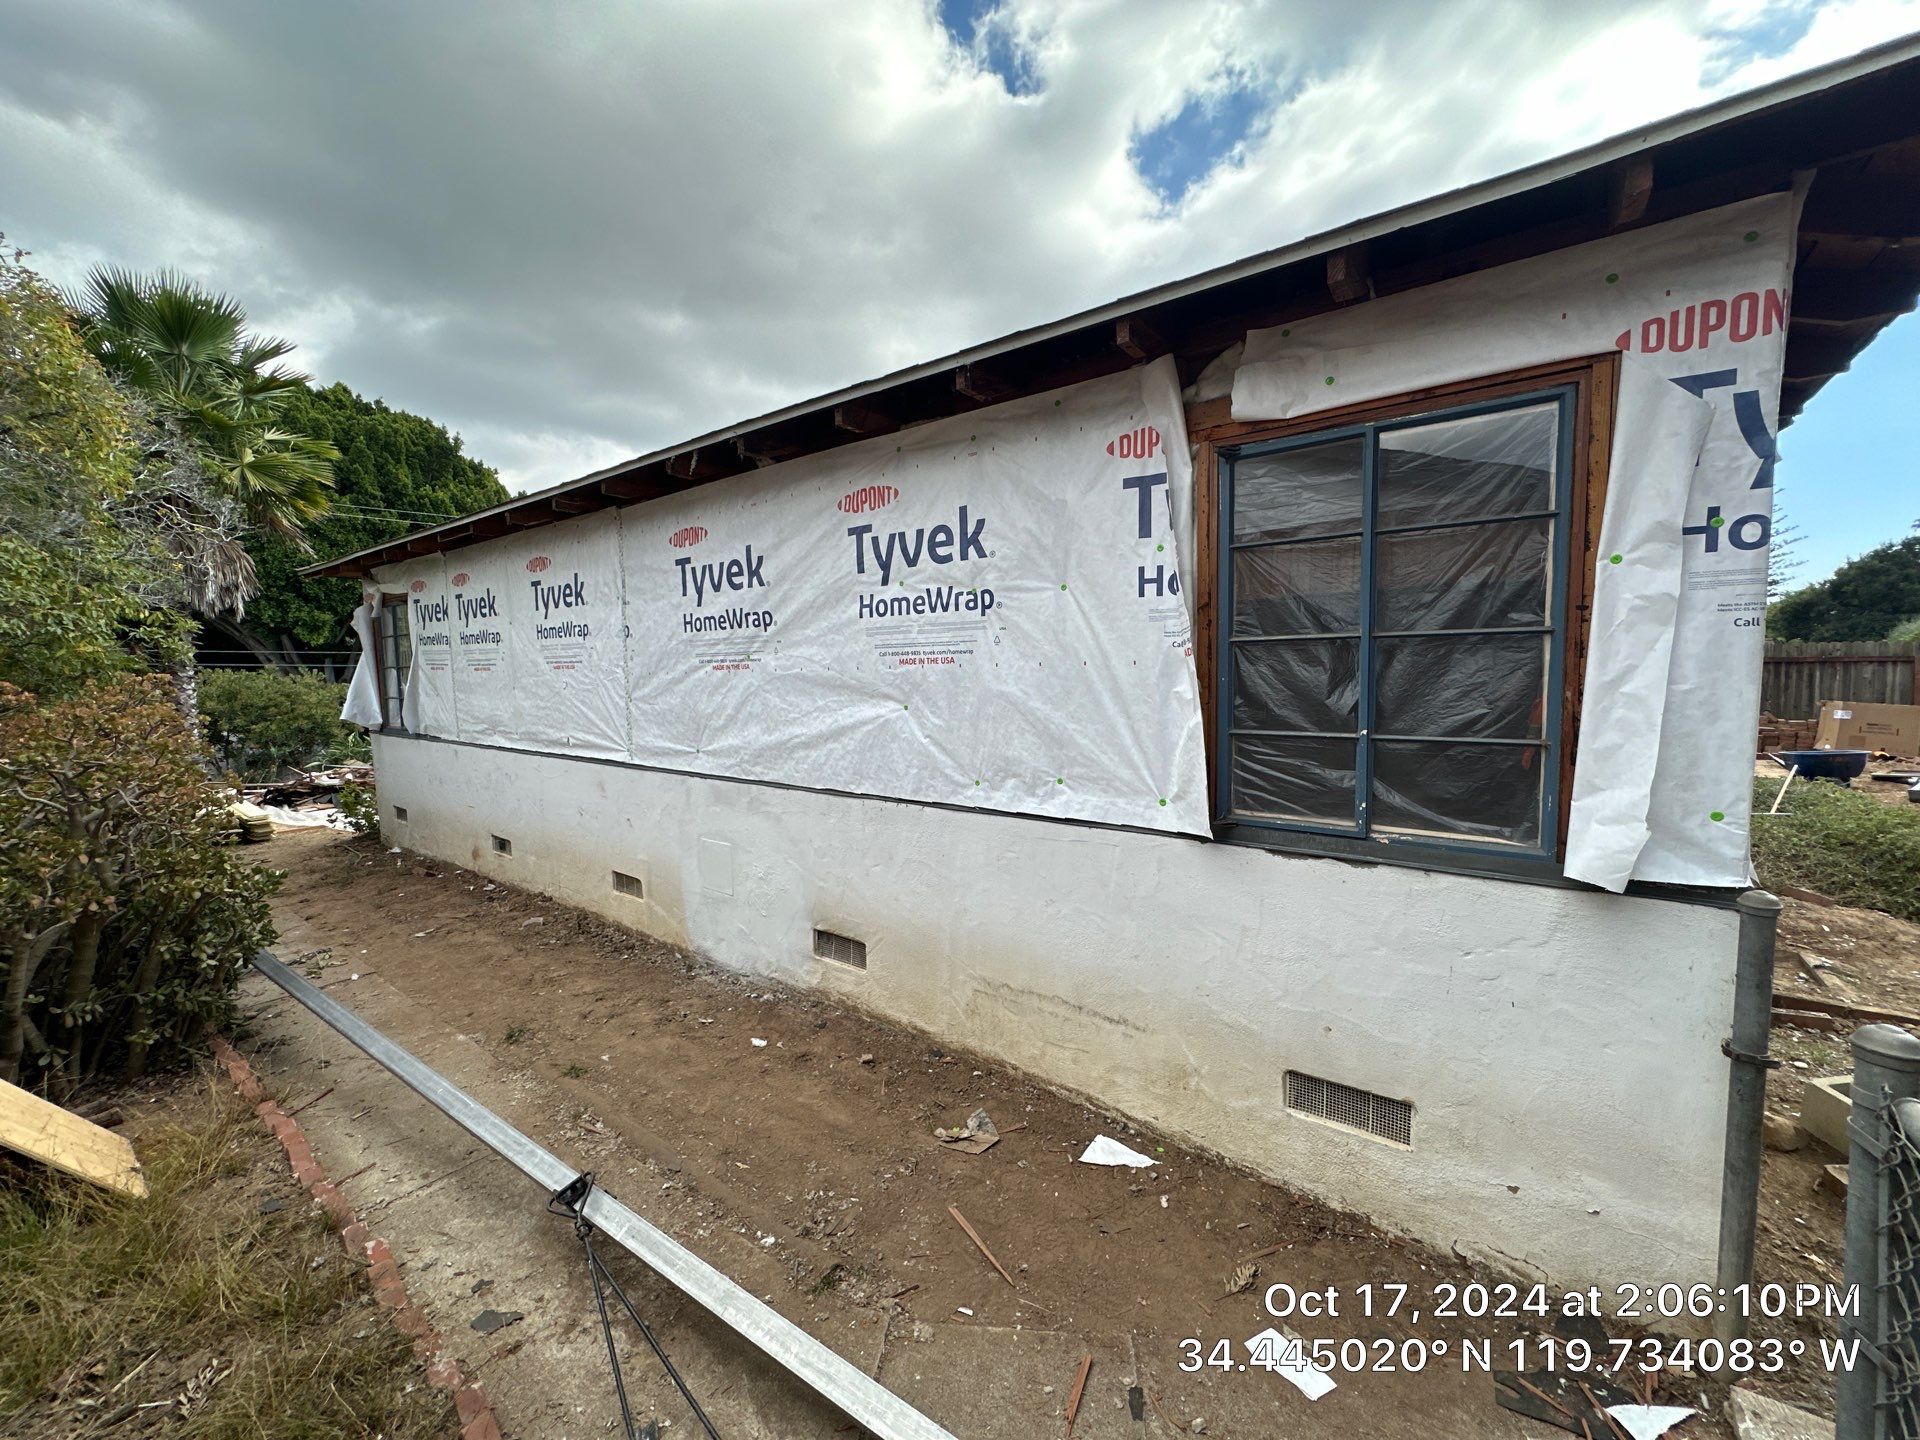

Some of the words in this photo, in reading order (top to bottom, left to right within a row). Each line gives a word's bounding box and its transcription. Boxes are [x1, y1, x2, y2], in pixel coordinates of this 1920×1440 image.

[1119, 425, 1166, 459] DUP
[844, 485, 893, 514] DUPONT
[1122, 471, 1174, 538] T
[673, 526, 704, 548] DUPONT
[847, 504, 988, 587] Tyvek
[675, 544, 766, 607] Tyvek
[413, 595, 450, 631] Tyvek
[455, 588, 498, 628] Tyvek
[531, 572, 586, 620] Tyvek
[859, 585, 996, 619] HomeWrap
[536, 621, 590, 641] HomeWrap
[683, 607, 774, 634] HomeWrap
[1734, 617, 1760, 627] Call
[460, 629, 502, 647] HomeWrap
[898, 658, 918, 666] MADE
[940, 656, 956, 664] USA
